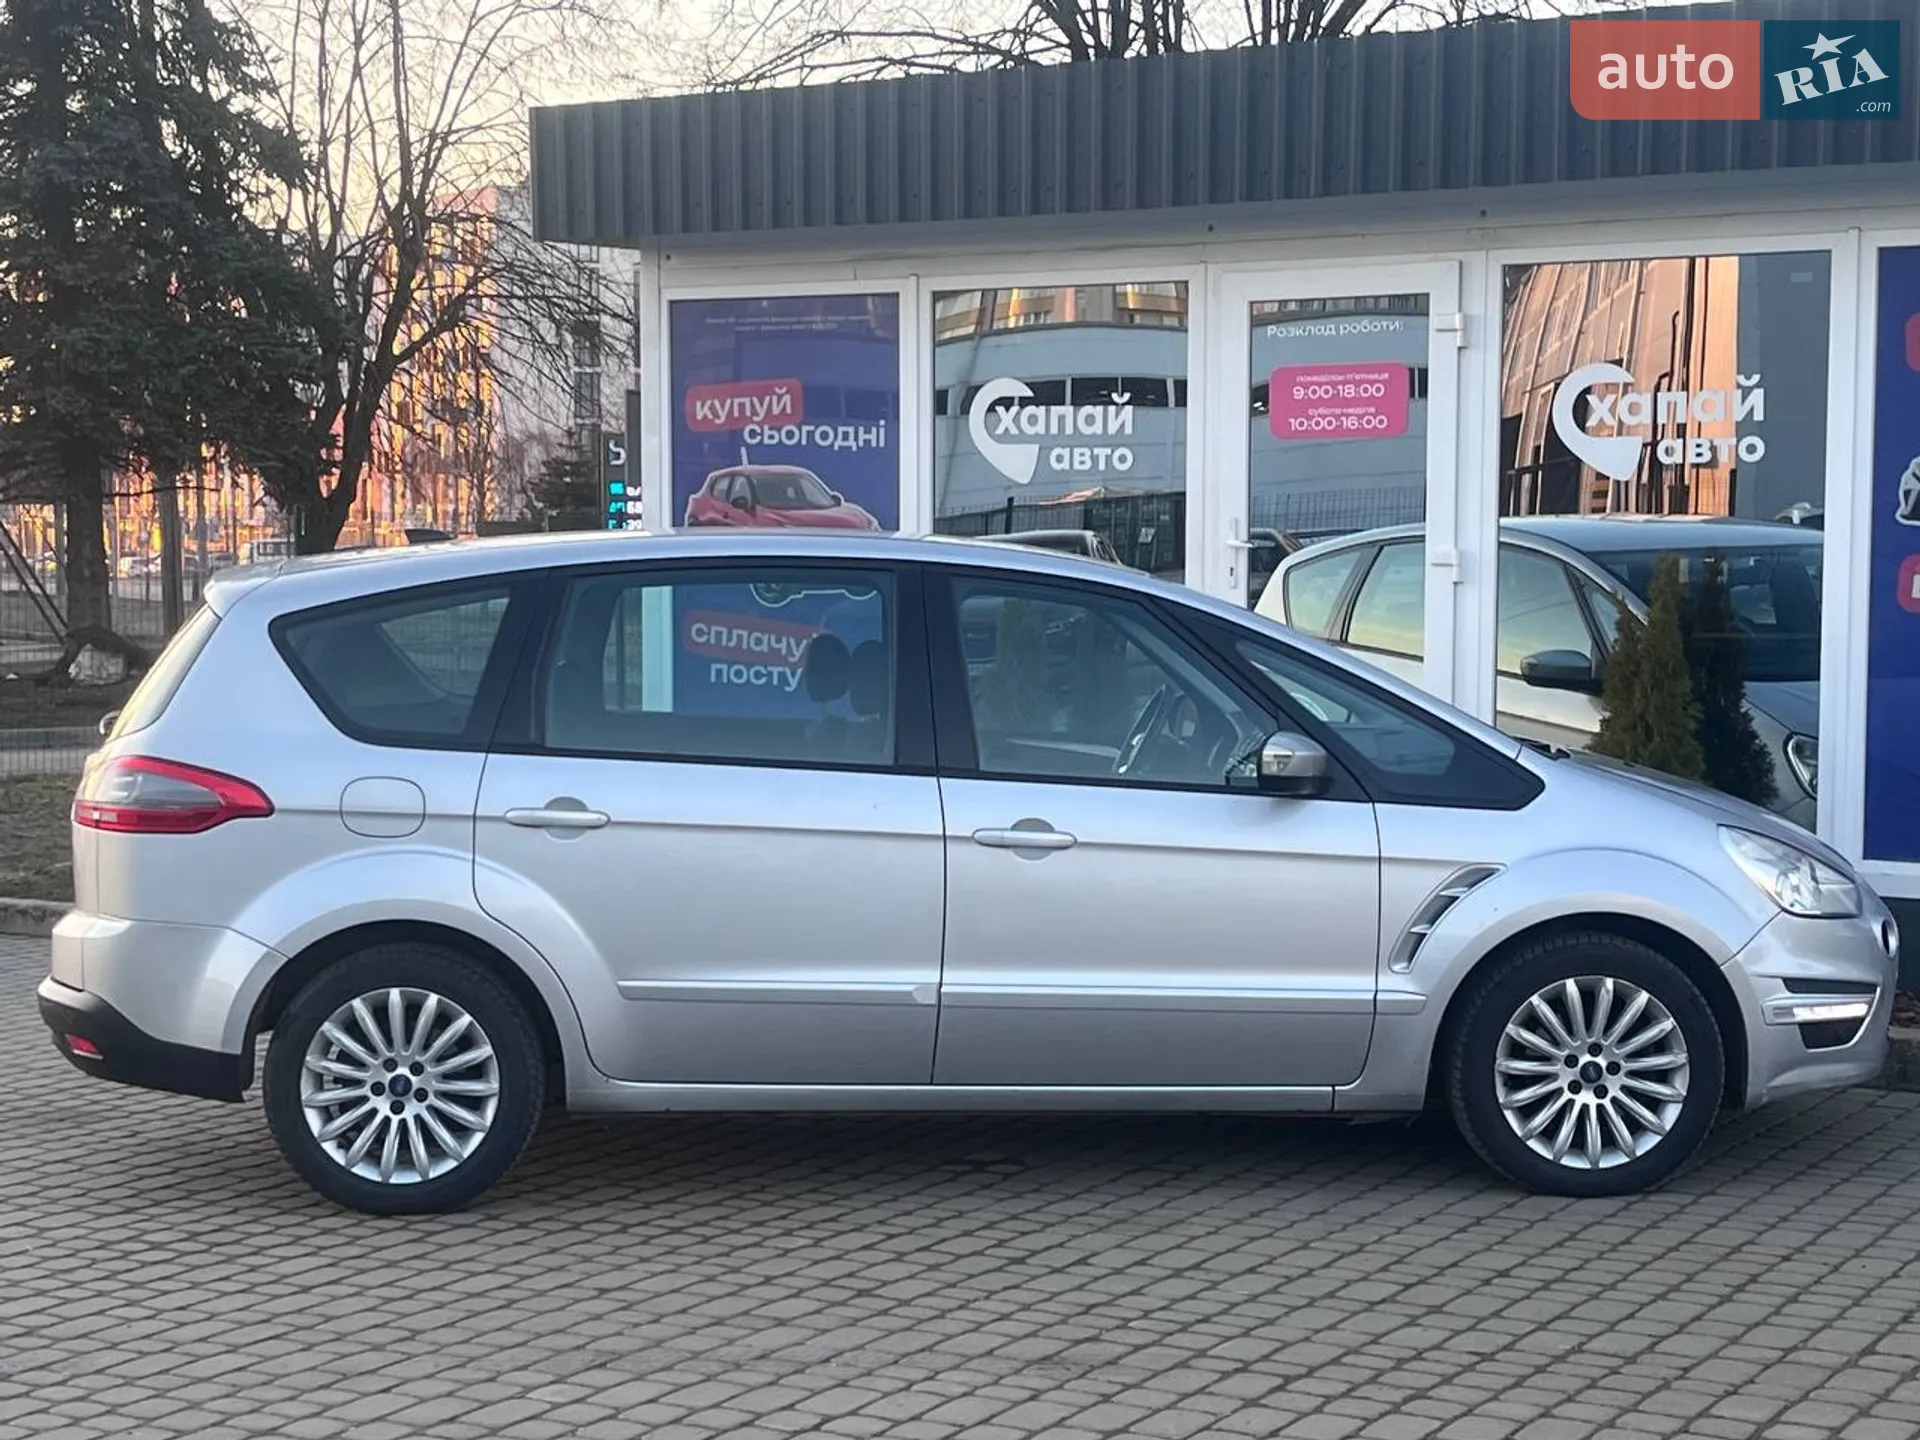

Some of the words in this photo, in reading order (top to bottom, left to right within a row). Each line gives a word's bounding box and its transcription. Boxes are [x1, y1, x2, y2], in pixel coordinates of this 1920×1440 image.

[1267, 324, 1336, 338] Розклад
[695, 386, 792, 424] купуй
[1292, 383, 1385, 399] 9:00-18:00
[743, 420, 886, 452] сьогодні
[1288, 415, 1388, 431] 10:00-16:00
[1049, 444, 1134, 472] авто
[1656, 435, 1766, 465] авто
[691, 622, 817, 663] сплачу
[710, 663, 804, 692] посту
